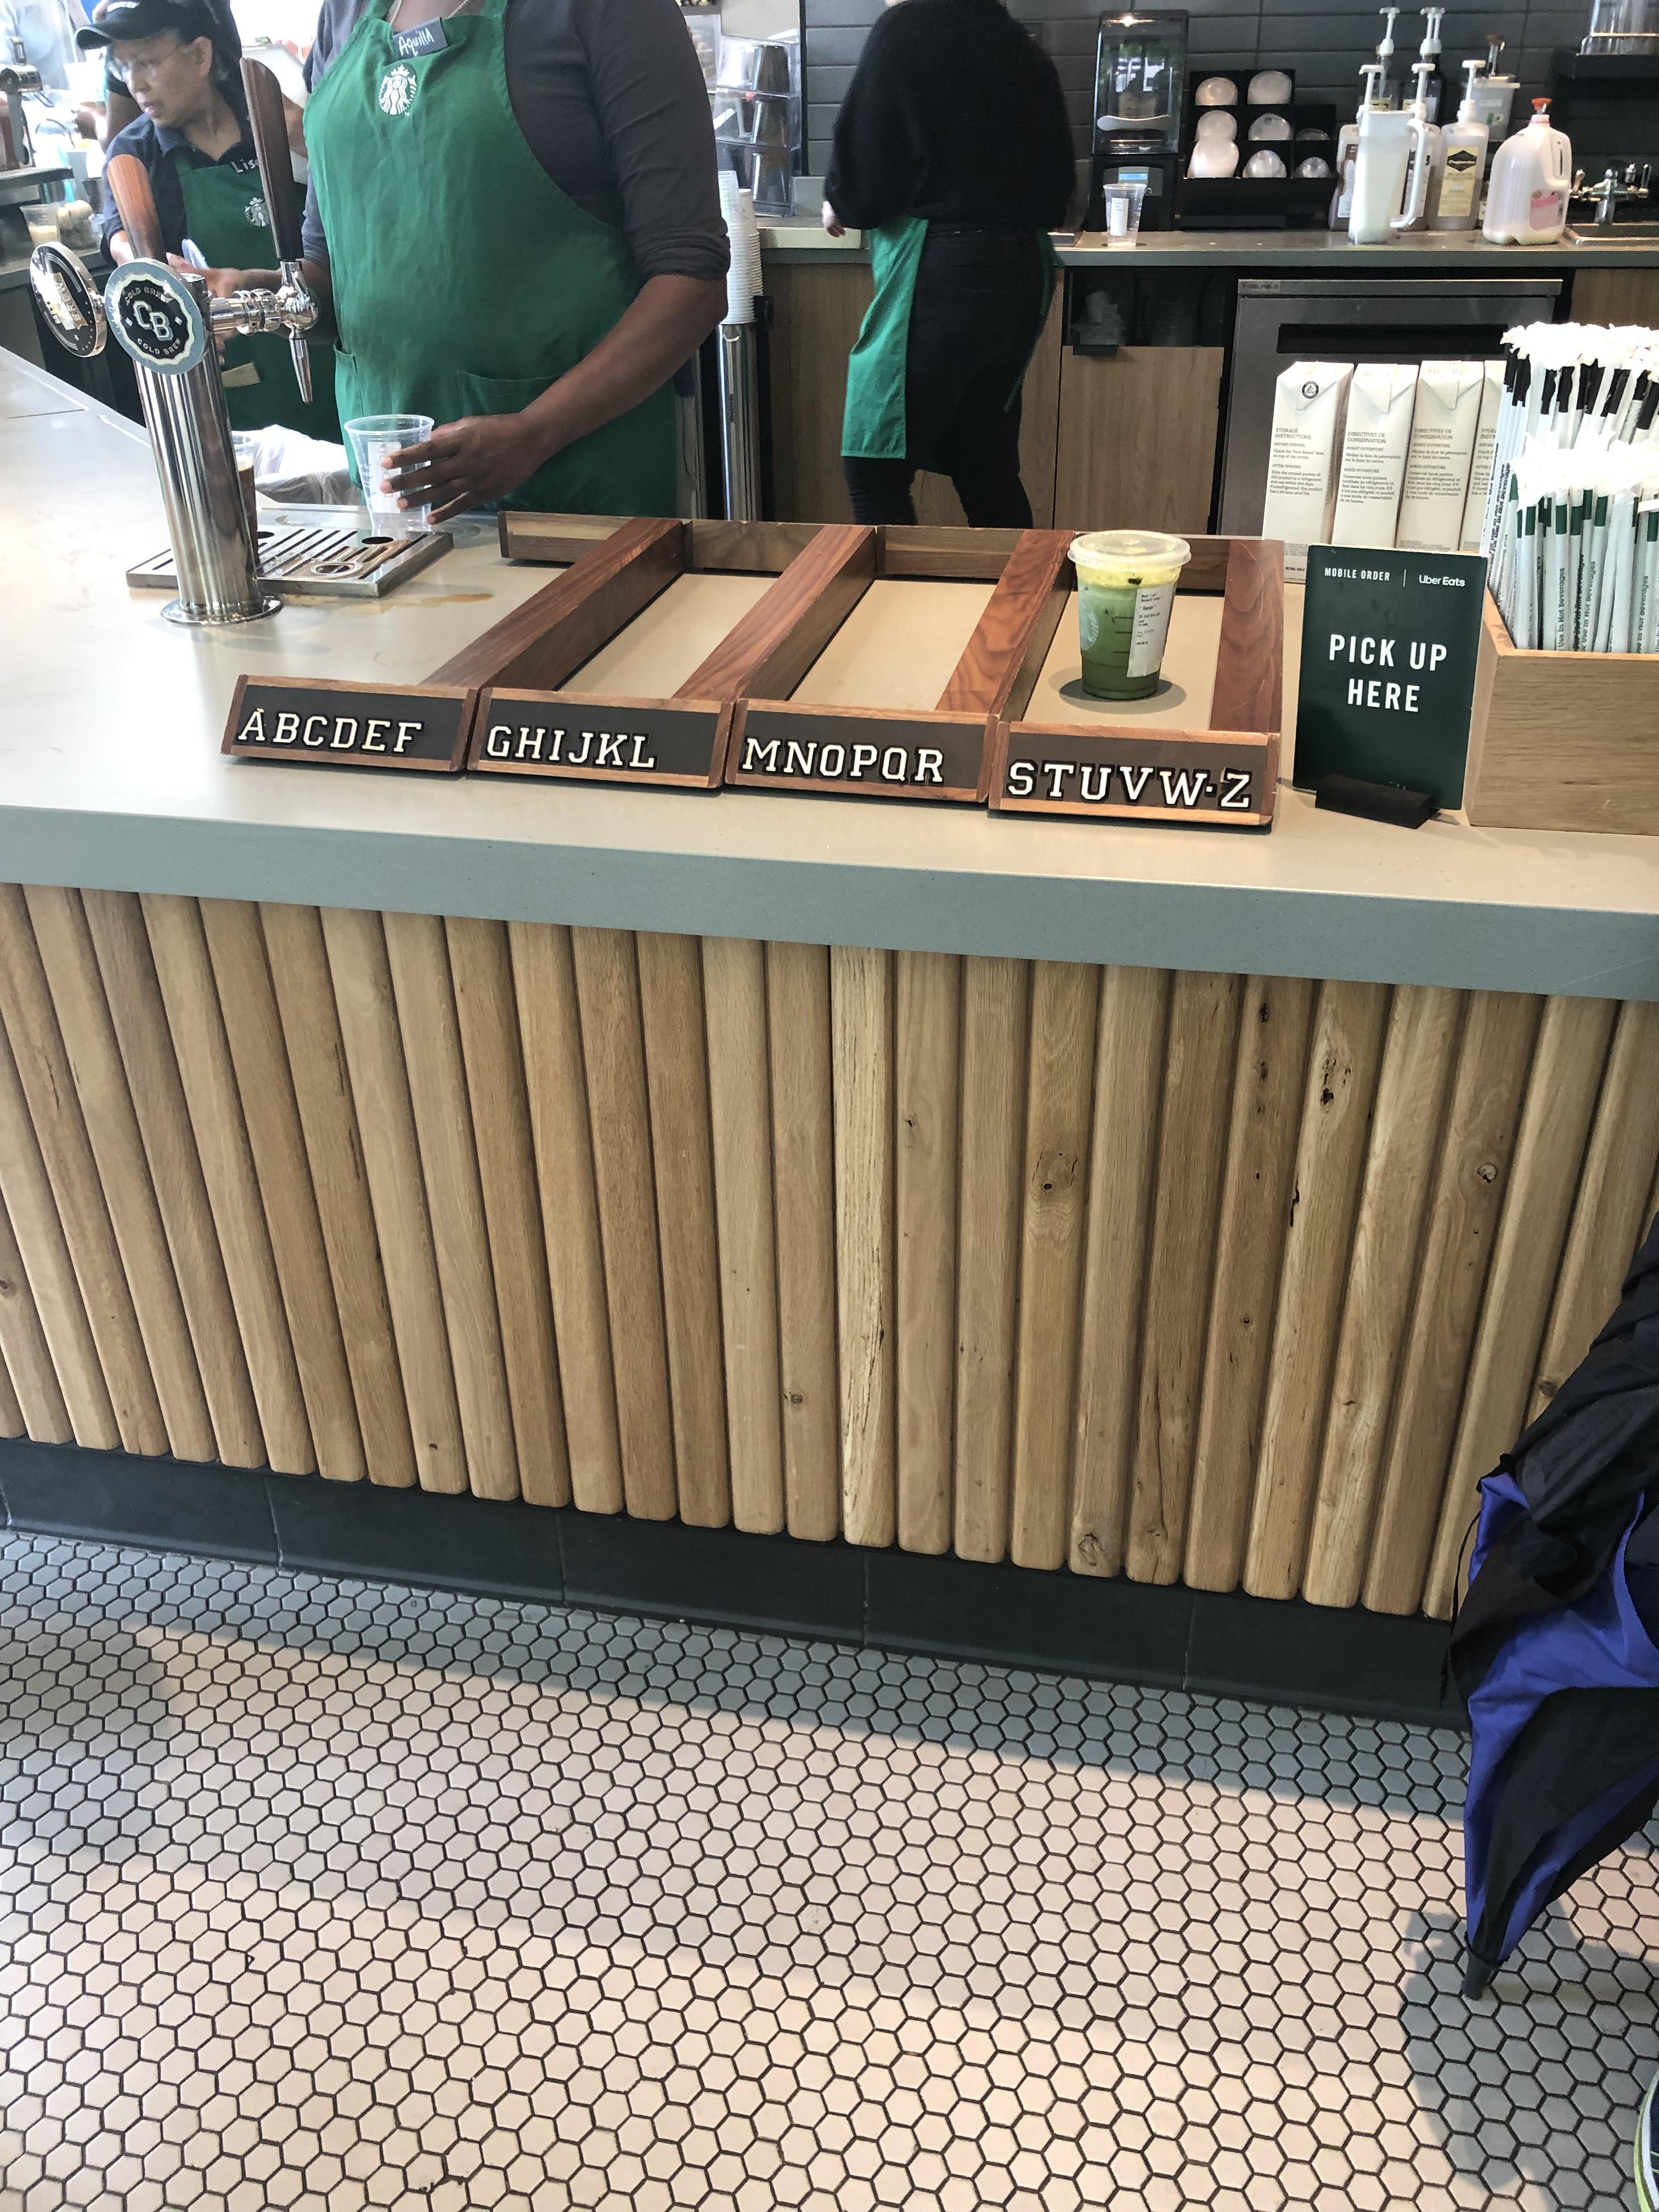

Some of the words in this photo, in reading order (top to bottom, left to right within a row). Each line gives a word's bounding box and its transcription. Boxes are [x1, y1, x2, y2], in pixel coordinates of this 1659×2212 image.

[124, 286, 142, 306] COLD
[133, 300, 173, 341] CB
[137, 338, 160, 354] COLD
[163, 337, 181, 355] BREW
[1324, 567, 1357, 579] MOBILE
[1361, 570, 1390, 581] ORDER
[1419, 574, 1441, 585] Uber
[1442, 577, 1465, 587] Eats
[1587, 561, 1596, 602] Beverages
[1329, 634, 1396, 667] PICK
[1409, 641, 1447, 672] UP
[1347, 678, 1420, 713] HERE
[237, 708, 422, 753] ABCDEF
[486, 725, 657, 769] GHIJKL
[742, 737, 944, 783] MNOPQR
